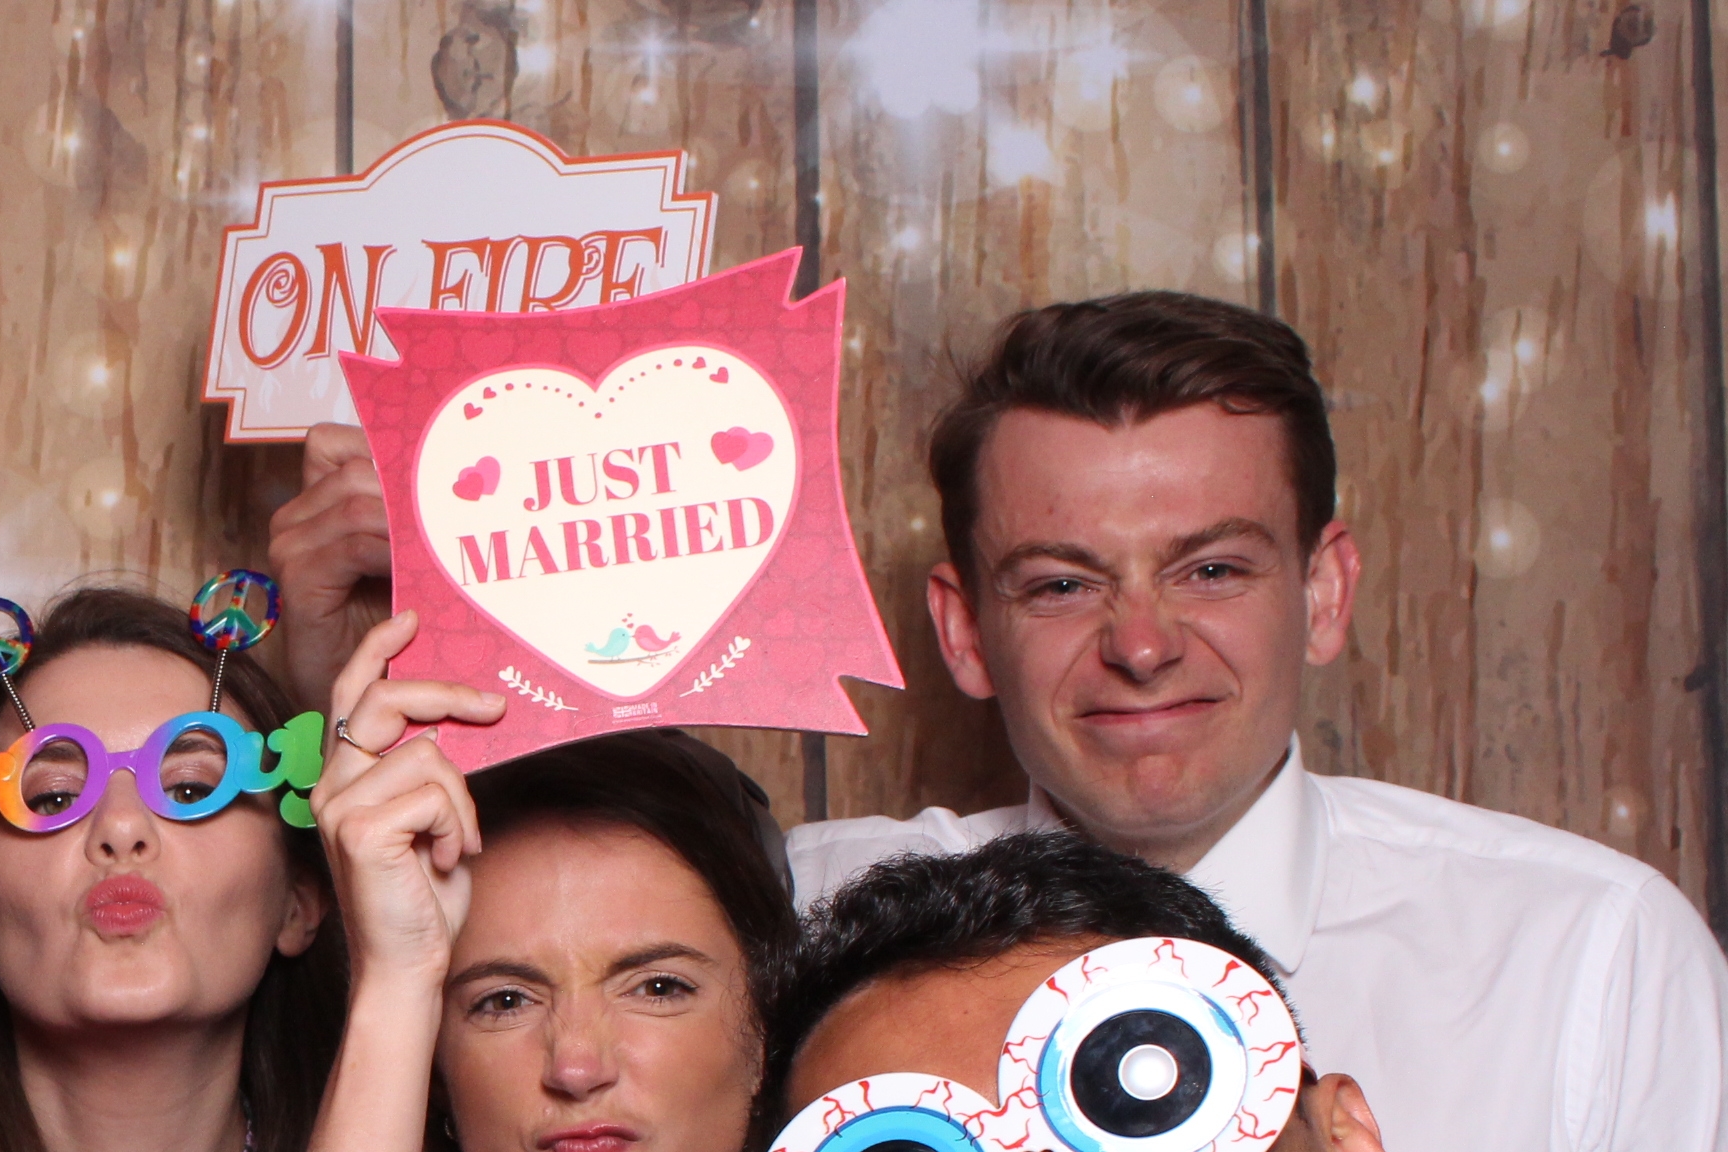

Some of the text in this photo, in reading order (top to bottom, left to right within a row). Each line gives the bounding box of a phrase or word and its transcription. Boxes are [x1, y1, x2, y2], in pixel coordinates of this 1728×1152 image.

[238, 226, 668, 371] ON FIRE
[522, 440, 683, 512] JUST
[456, 496, 775, 587] MARRIED
